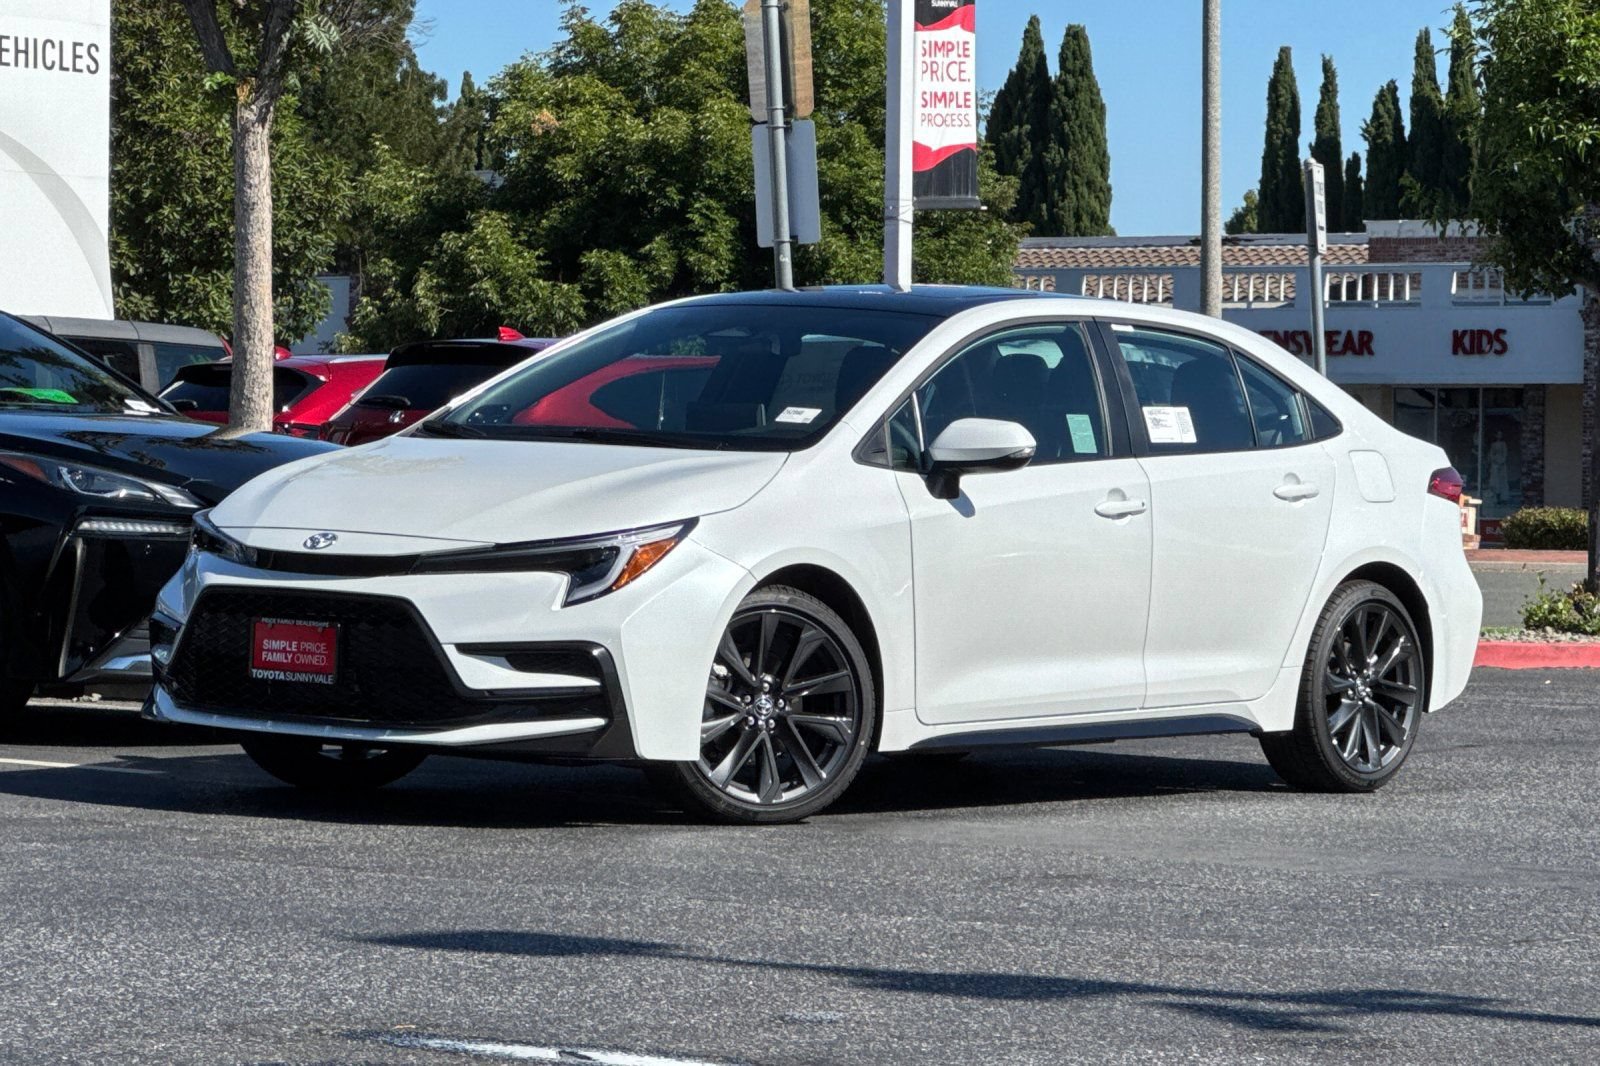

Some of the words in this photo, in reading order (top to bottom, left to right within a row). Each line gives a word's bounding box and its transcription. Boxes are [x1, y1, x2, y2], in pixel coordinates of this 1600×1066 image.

[921, 40, 971, 58] SIMPLE
[921, 60, 971, 82] PRICE.
[921, 91, 971, 109] SIMPLE
[1452, 328, 1509, 356] KIDS
[263, 639, 299, 651] SIMPLE
[262, 651, 293, 663] FAMILY
[251, 669, 285, 681] TOYOTA
[285, 671, 334, 685] SUNNYVALE
